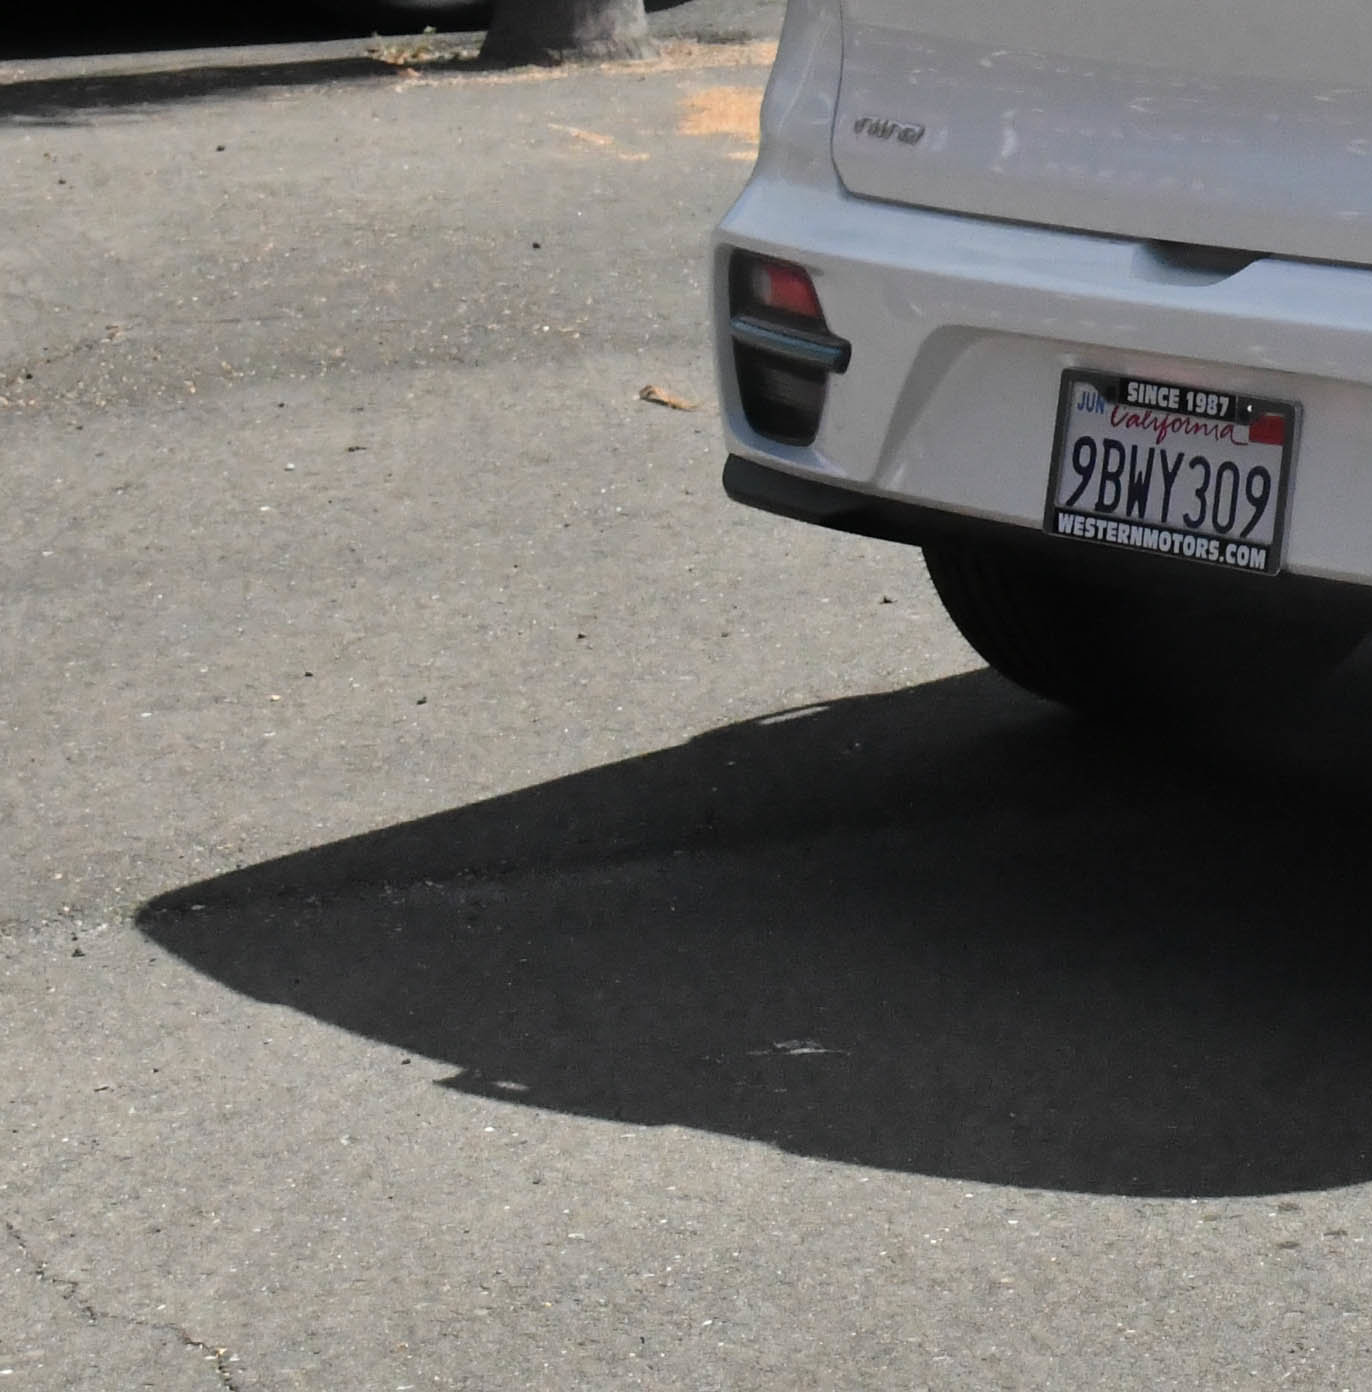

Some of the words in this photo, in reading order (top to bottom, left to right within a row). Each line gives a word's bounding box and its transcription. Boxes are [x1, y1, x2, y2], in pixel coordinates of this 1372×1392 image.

[1076, 391, 1106, 414] JUN
[1127, 380, 1180, 409] SINCE
[1185, 391, 1230, 417] 1987
[1109, 404, 1250, 446] California
[1065, 435, 1272, 539] 9BWY309
[1057, 511, 1267, 570] WESTERNMOTORS.COM
